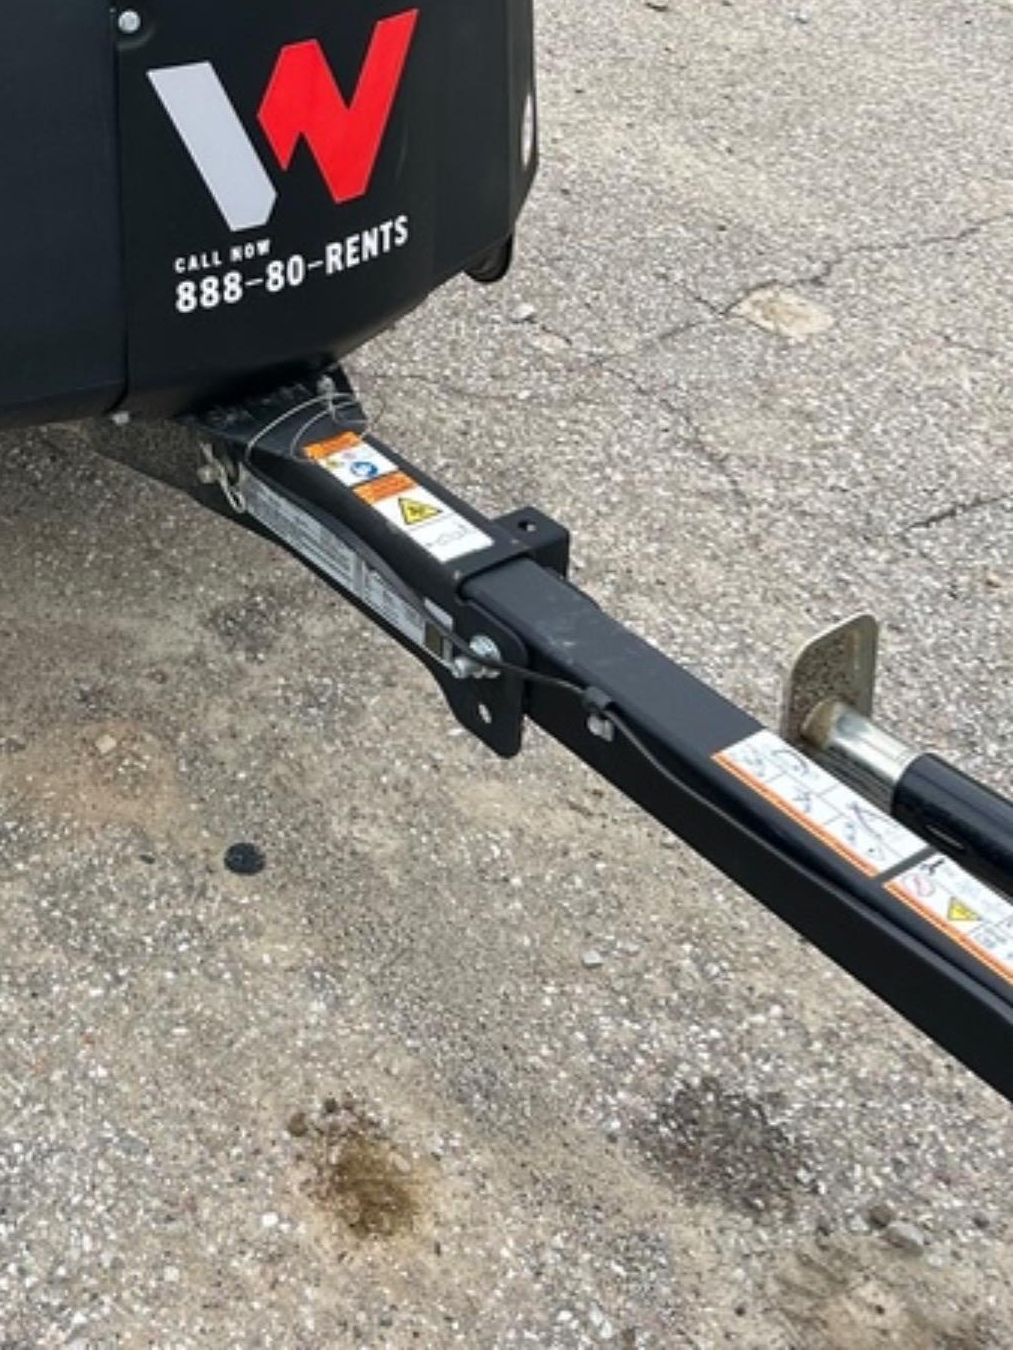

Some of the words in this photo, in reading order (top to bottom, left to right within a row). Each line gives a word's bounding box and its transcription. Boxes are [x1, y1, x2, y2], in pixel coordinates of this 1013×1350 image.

[175, 251, 222, 273] CALL
[230, 239, 270, 261] NOW
[175, 215, 409, 312] 888-80-RENTS
